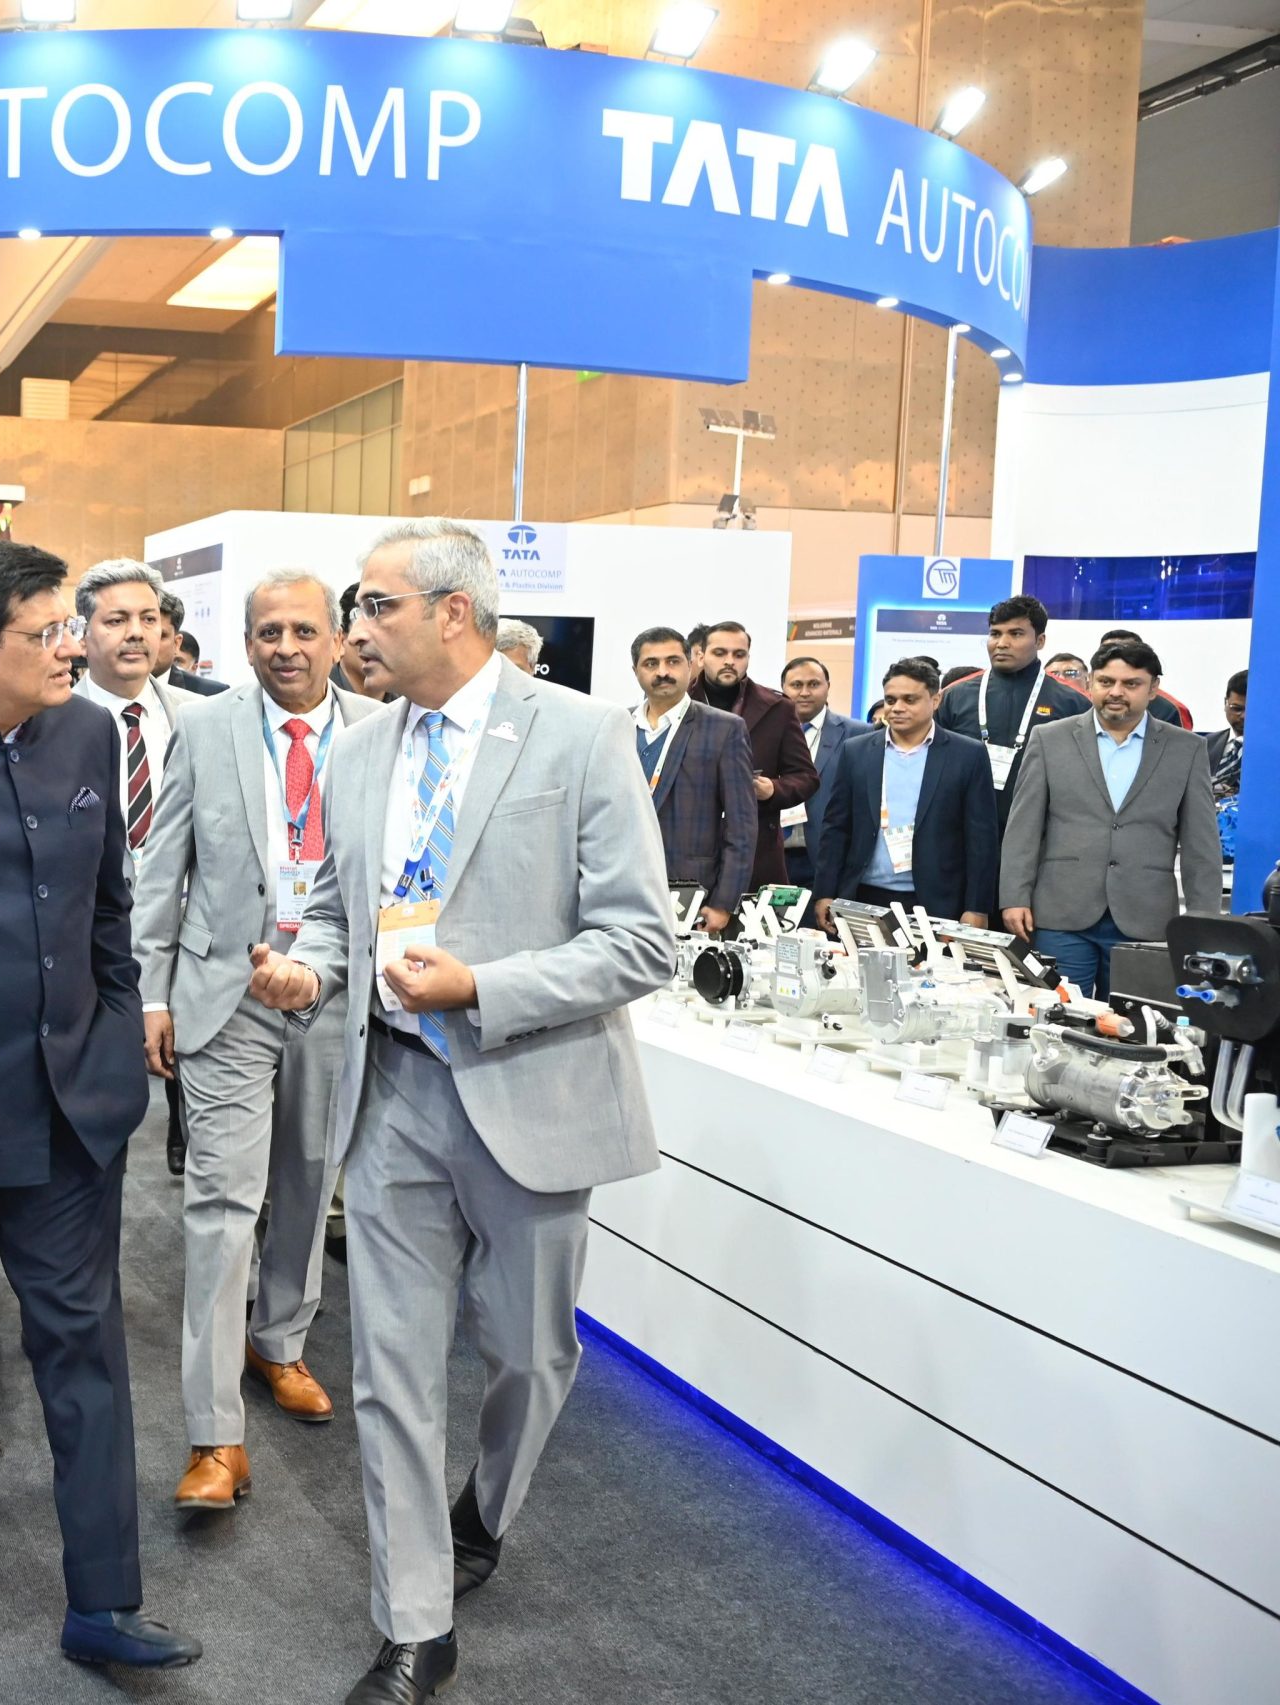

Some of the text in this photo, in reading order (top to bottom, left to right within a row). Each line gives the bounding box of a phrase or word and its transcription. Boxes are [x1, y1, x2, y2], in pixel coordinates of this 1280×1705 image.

[602, 109, 849, 238] TATA
[501, 549, 541, 561] TATA
[510, 569, 563, 579] AUTOCOMP
